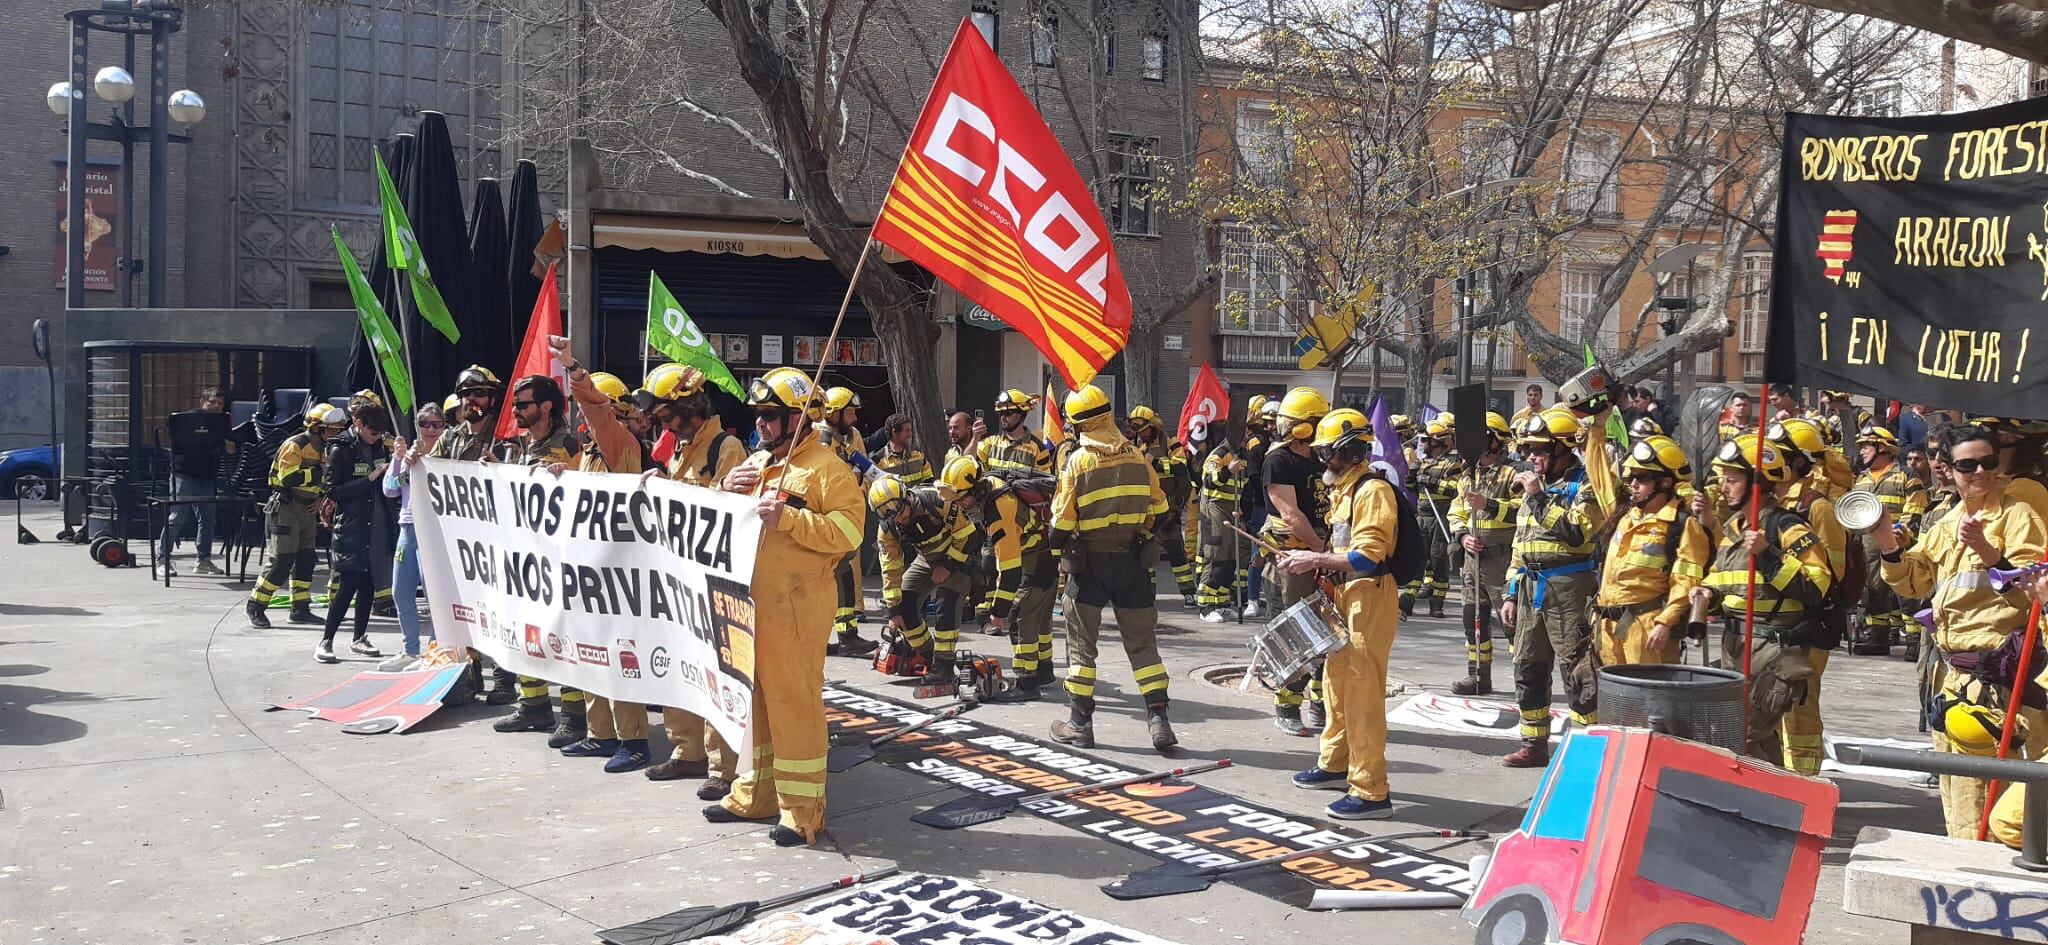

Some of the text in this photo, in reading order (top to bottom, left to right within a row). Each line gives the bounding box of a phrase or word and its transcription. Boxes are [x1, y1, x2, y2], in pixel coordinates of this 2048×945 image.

[1800, 120, 2048, 182] BOMBEROS FOREST
[707, 240, 744, 252] KIOSKO
[1895, 216, 2010, 267] ARAGON
[1845, 271, 1861, 288] 44
[663, 309, 712, 351] OS
[1847, 317, 1887, 365] EN
[1917, 325, 2001, 383] LUCHA
[427, 472, 733, 573] SARGA NOS PRECARIZA
[457, 538, 499, 592] DGA
[504, 550, 553, 607] NOS
[561, 562, 717, 650] PRIVATIZA
[578, 646, 608, 662] CCOO
[622, 667, 641, 678] CGT
[654, 654, 671, 669] CSIF
[906, 758, 1027, 796] SARGA
[920, 741, 1187, 826] PRECARIDAD
[1185, 827, 1424, 892] LABORA
[1021, 798, 1091, 818] EN
[1082, 819, 1241, 868] LUCHA
